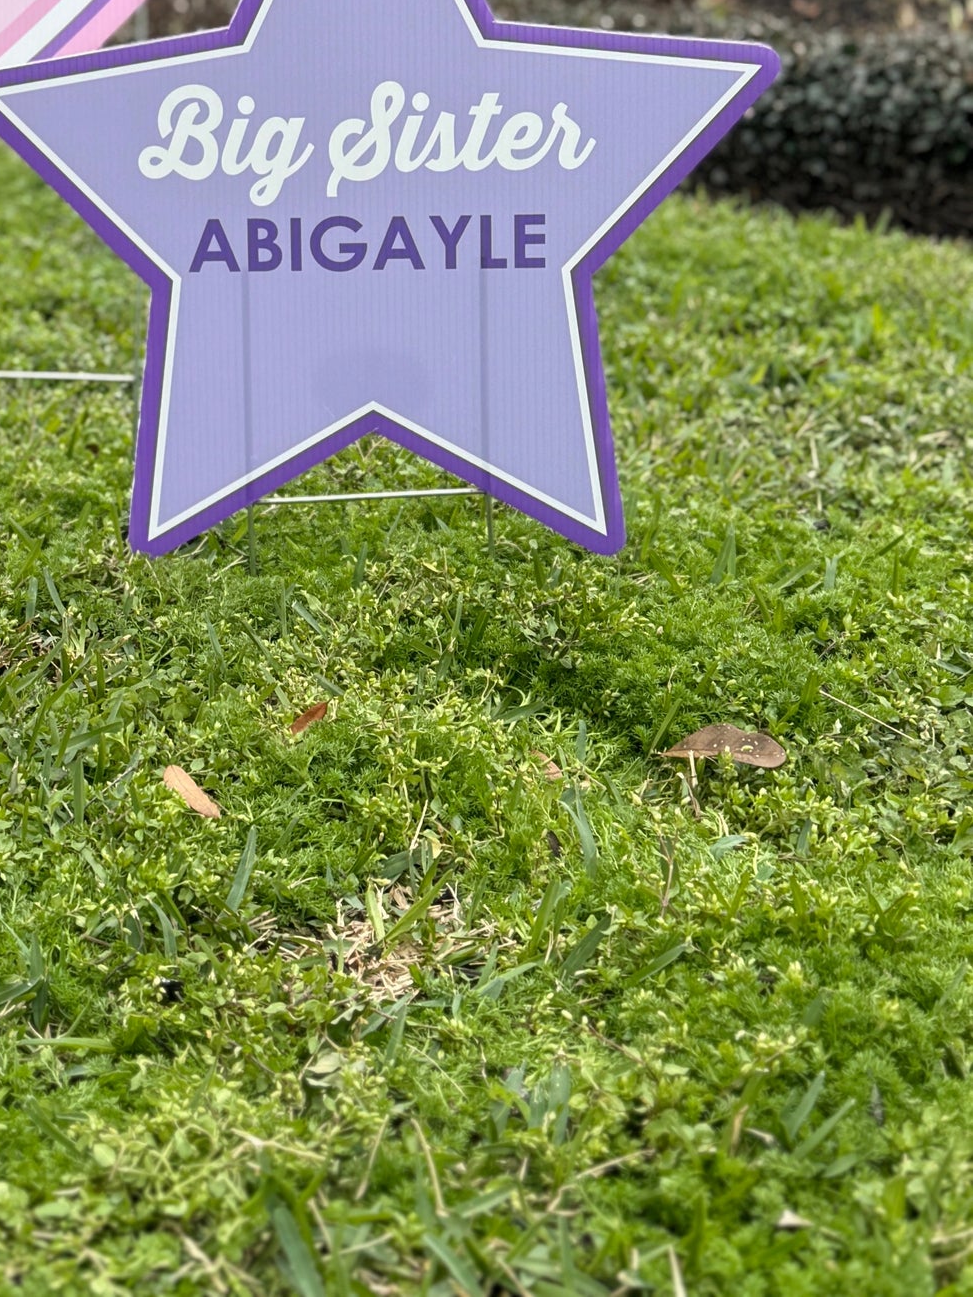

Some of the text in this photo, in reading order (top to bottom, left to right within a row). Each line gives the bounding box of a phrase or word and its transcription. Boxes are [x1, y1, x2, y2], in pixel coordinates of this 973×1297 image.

[138, 80, 596, 206] Big Sister
[188, 213, 546, 272] ABIGAYLE
